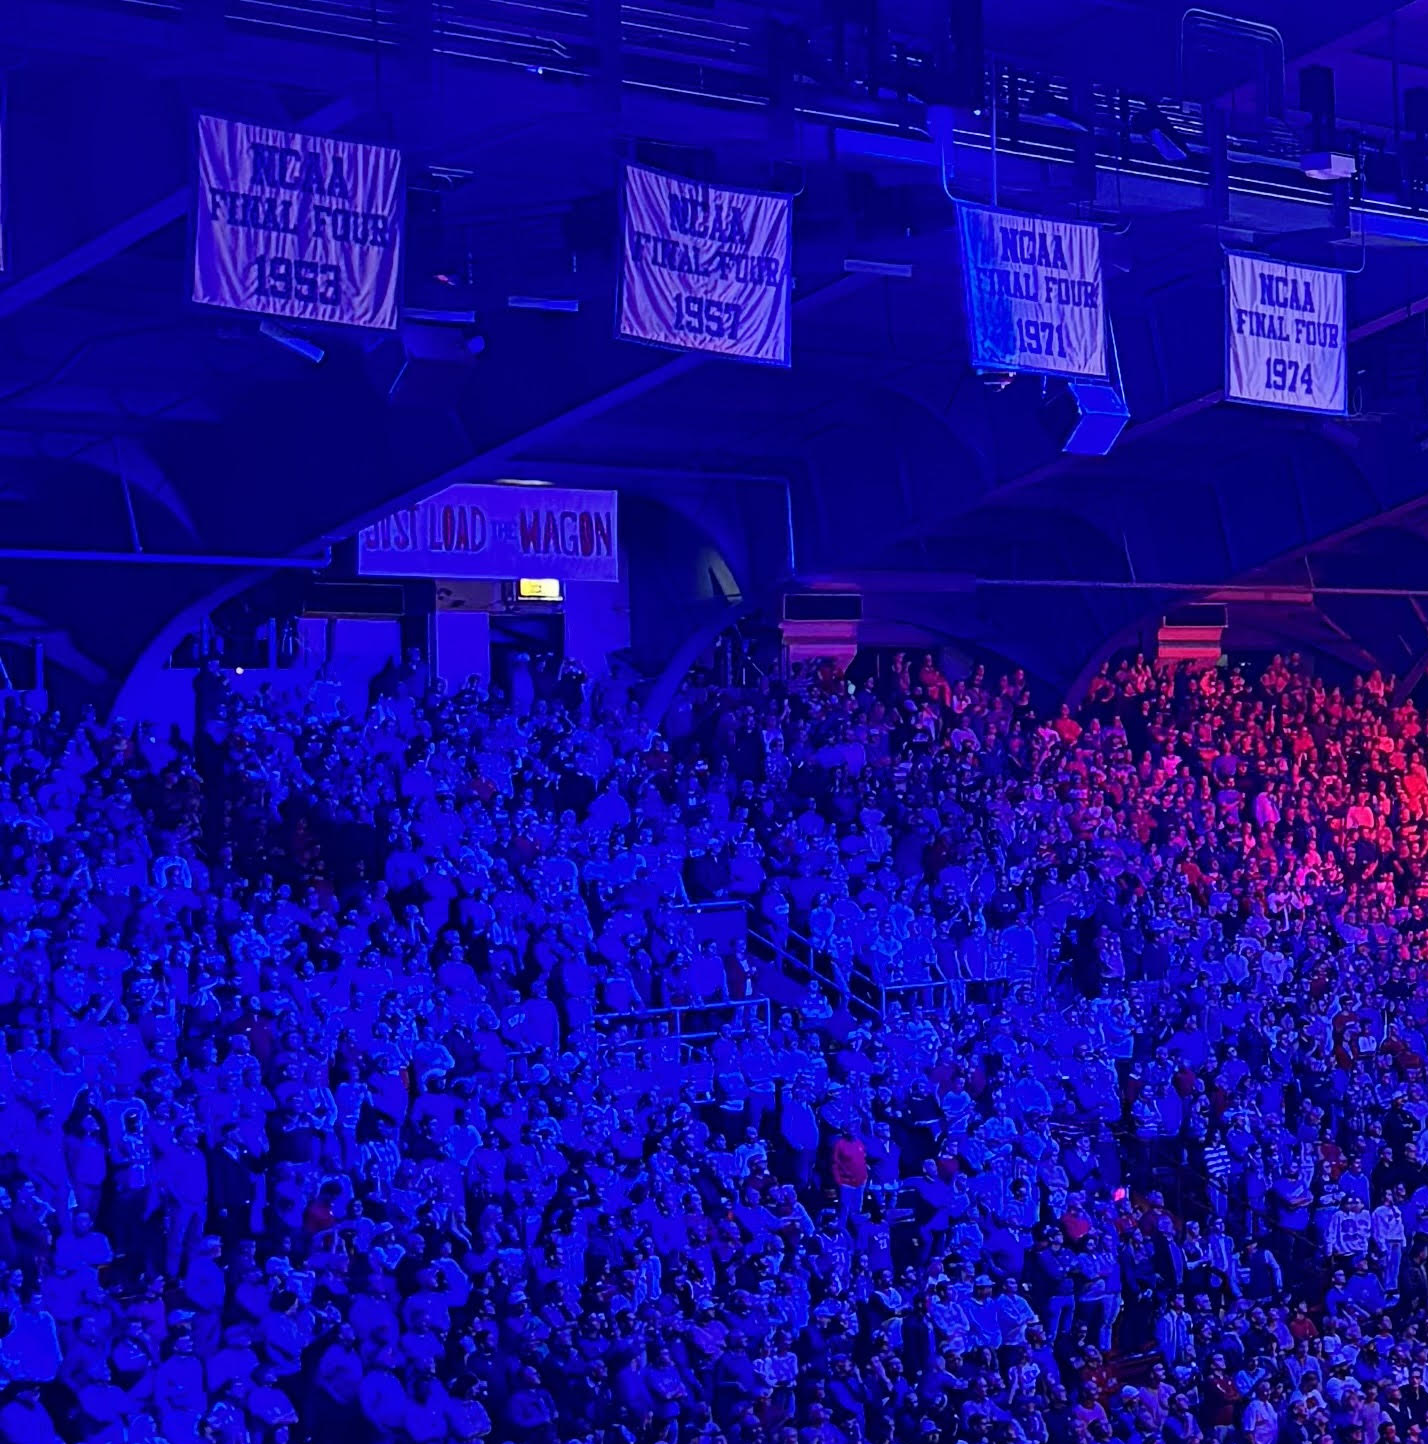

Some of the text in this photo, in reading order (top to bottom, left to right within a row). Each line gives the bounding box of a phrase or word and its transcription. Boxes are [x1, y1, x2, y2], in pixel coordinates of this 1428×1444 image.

[250, 143, 350, 199] NCAA
[209, 187, 388, 248] FINAL FOUR
[668, 194, 747, 245] NCAA
[632, 230, 780, 287] FINAL FOUR
[1000, 226, 1068, 270] NCAA
[252, 254, 341, 306] 1953
[977, 267, 1098, 309] FINAL FOUR
[1259, 273, 1315, 313] NCAA
[1016, 318, 1066, 358] 1971
[1236, 309, 1339, 349] FINAL FOUR
[1265, 357, 1313, 395] 1974
[427, 503, 488, 552] LOAD
[518, 508, 613, 557] WAGON
